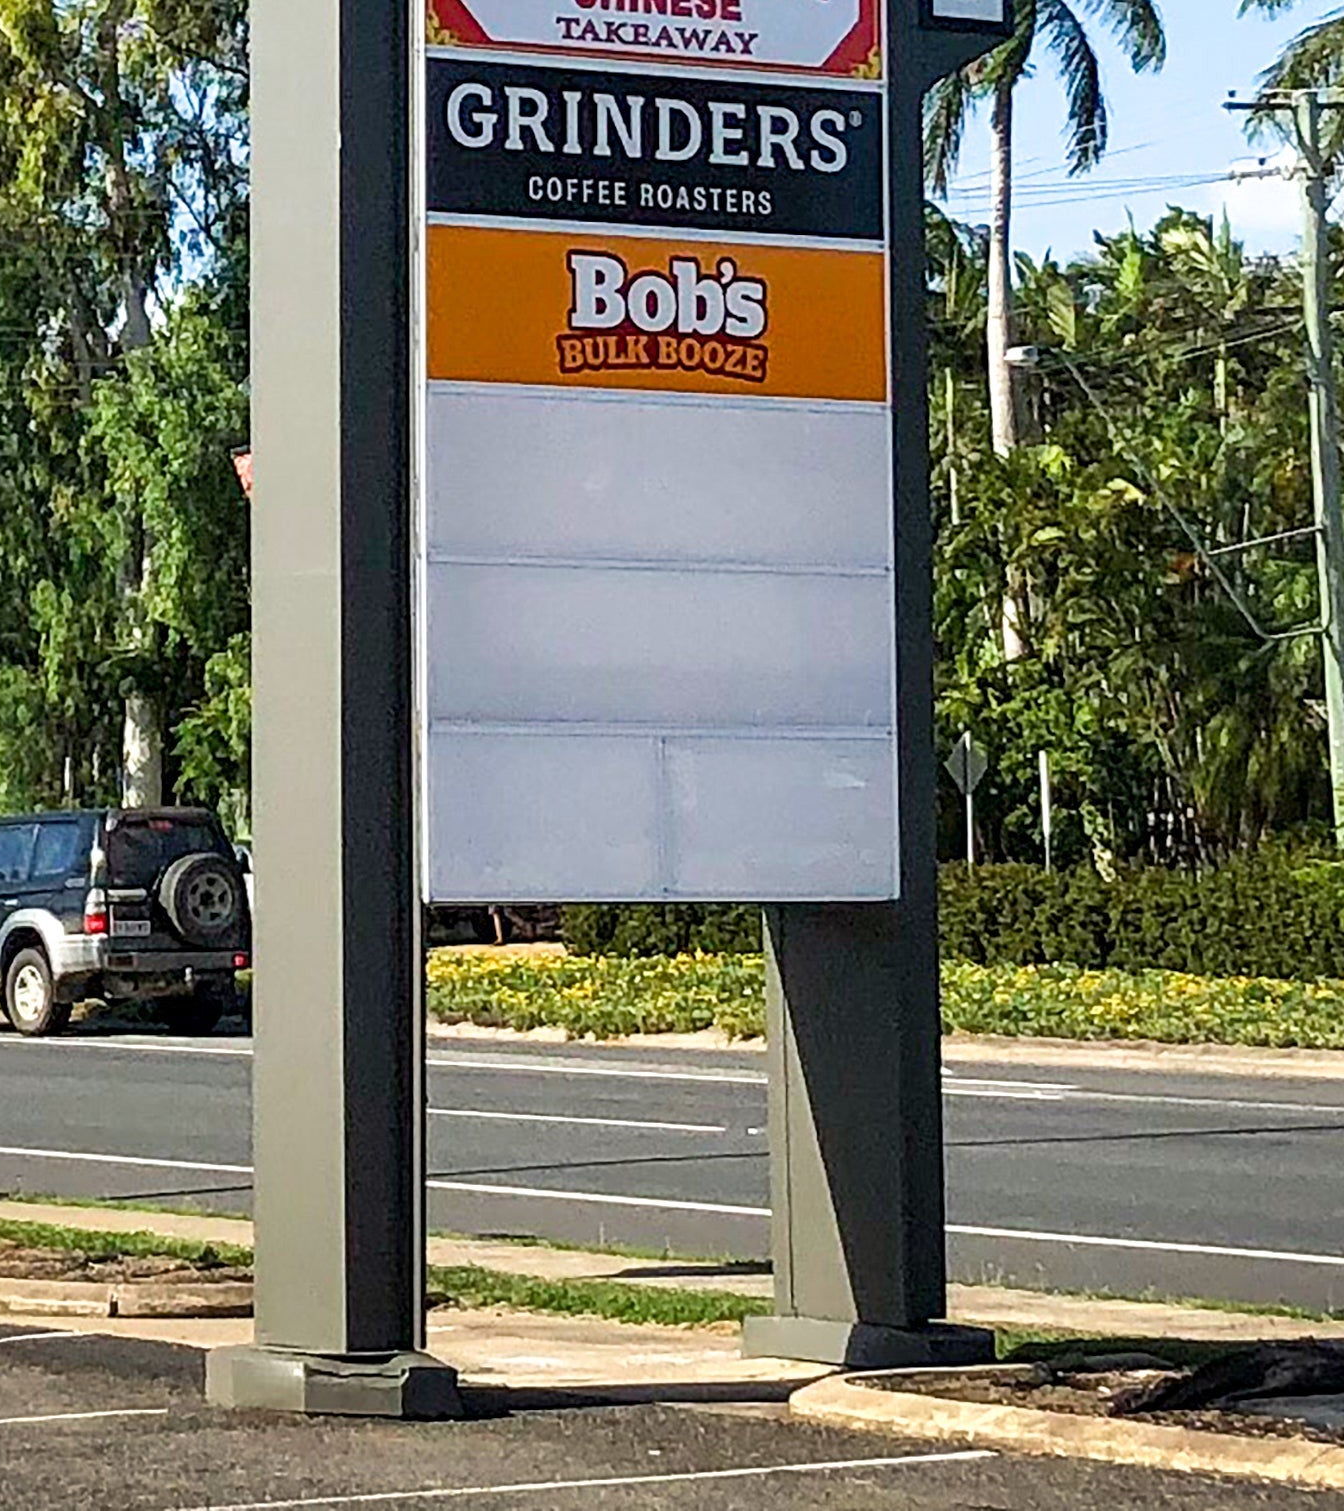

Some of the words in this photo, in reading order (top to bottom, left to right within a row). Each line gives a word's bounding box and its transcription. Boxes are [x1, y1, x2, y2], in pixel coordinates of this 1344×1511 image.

[560, 17, 758, 55] TAKEAWAY
[447, 83, 847, 173] GRINDERS
[529, 176, 627, 206] COFFEE
[640, 184, 773, 215] ROASTERS
[570, 254, 765, 338] Bob's
[561, 338, 650, 371] BULK
[658, 340, 765, 380] BOOZE
